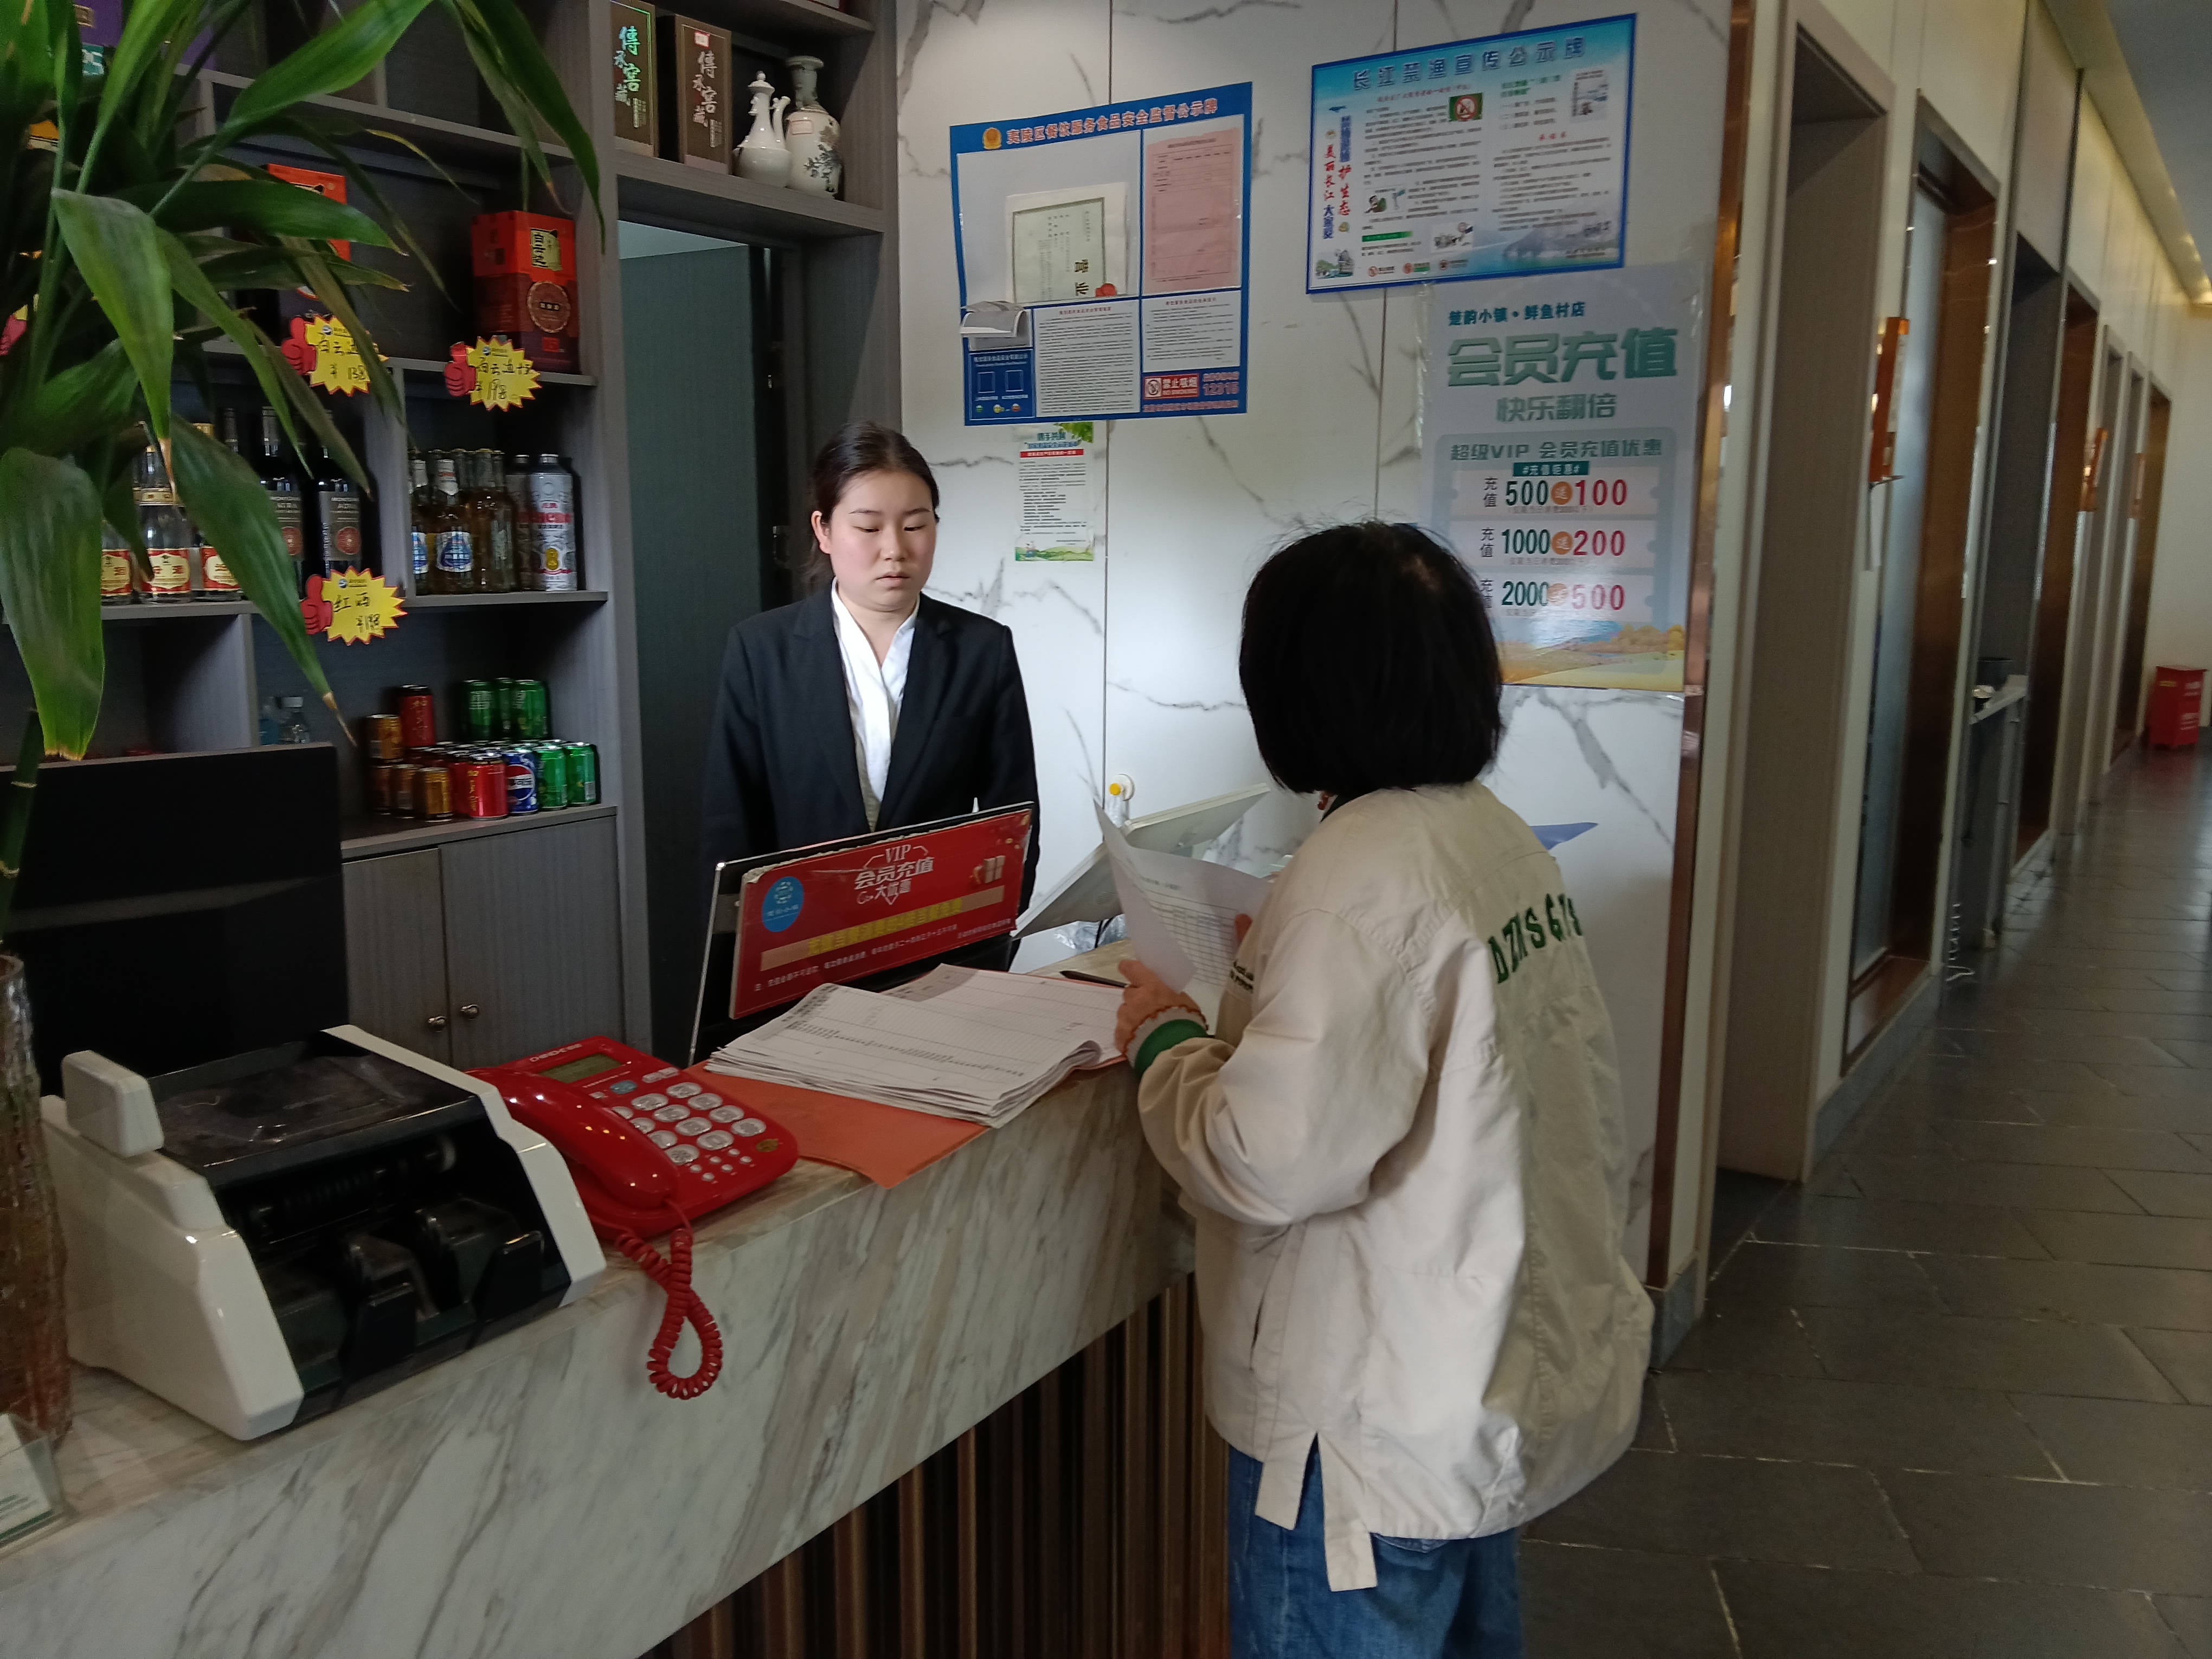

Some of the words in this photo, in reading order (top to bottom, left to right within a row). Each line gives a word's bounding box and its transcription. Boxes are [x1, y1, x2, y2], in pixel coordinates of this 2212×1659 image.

[1006, 98, 1218, 145] 夷陵区餐饮服务食品安全监督公示牌
[1448, 327, 1678, 387] 会员充值
[1203, 382, 1240, 396] 12315
[1496, 394, 1617, 423] 快乐翻倍
[1450, 443, 1529, 461] 超级VIP
[1539, 438, 1662, 460] 会员充值优惠
[1483, 476, 1498, 509] 充值
[1505, 480, 1548, 506] 500
[1574, 479, 1627, 506] 100
[1480, 528, 1495, 558] 充值
[1501, 529, 1551, 555] 1000
[1573, 530, 1625, 556] 200
[1501, 581, 1549, 607] 2000
[1572, 584, 1625, 611] 500
[885, 844, 912, 864] VIP
[854, 856, 935, 890] 会员充值
